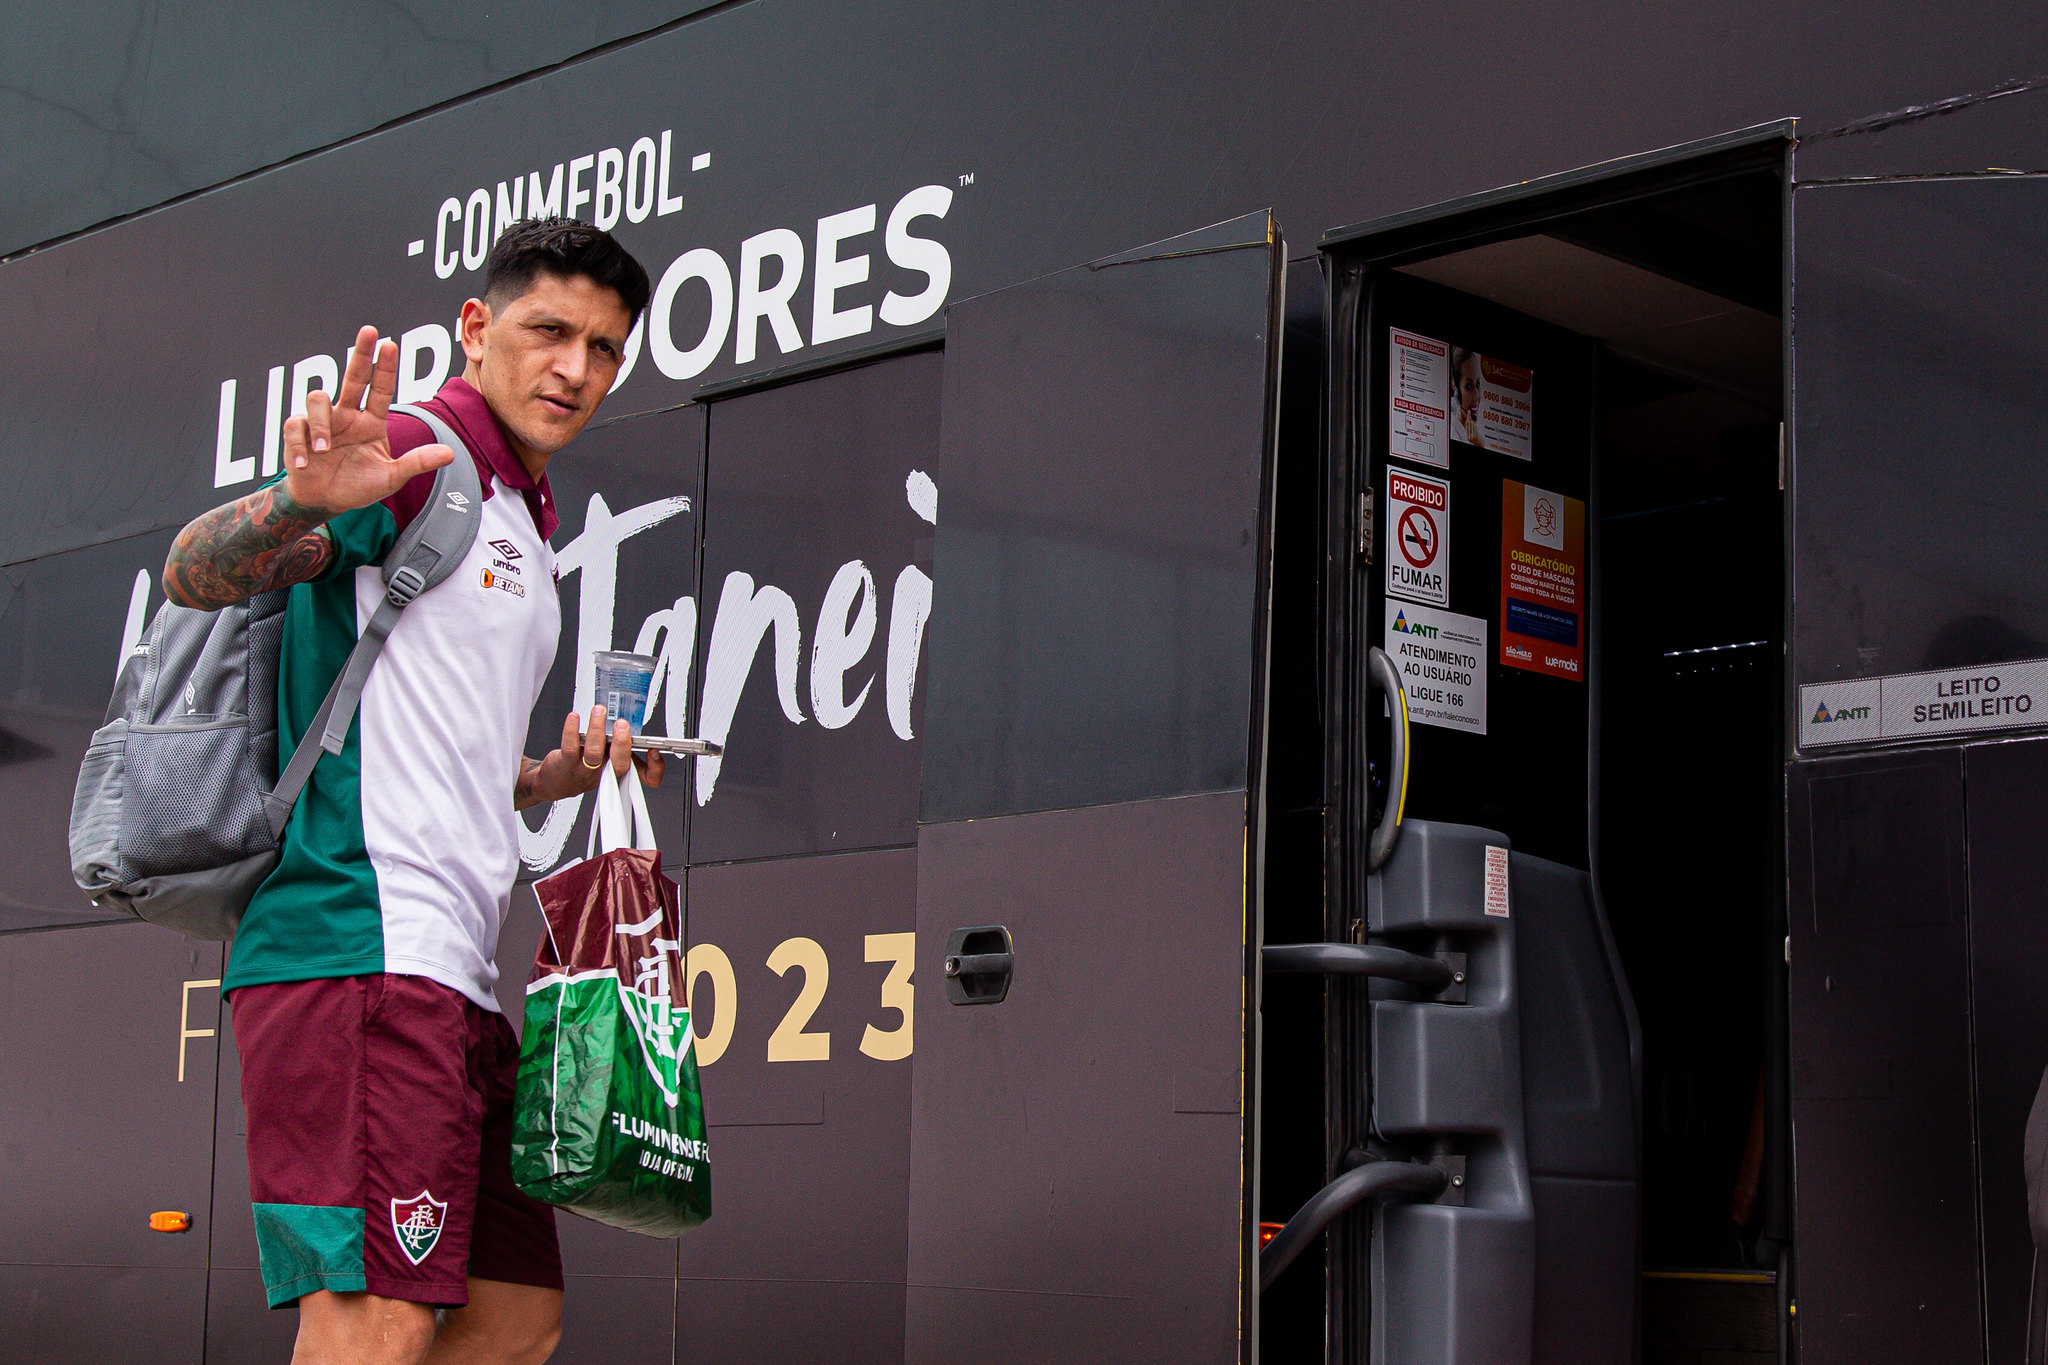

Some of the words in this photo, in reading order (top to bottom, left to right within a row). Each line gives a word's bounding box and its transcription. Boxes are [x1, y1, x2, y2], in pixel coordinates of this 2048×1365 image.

[434, 129, 683, 279] CONMEBOL
[1393, 479, 1443, 507] PROIBIDO
[446, 503, 467, 514] umbro
[493, 558, 521, 575] umbro
[1511, 549, 1575, 576] OBRIGATÓRIO
[1392, 565, 1442, 592] FUMAR
[1510, 562, 1517, 571] O
[1517, 563, 1532, 575] USO
[1532, 568, 1542, 578] DE
[1543, 570, 1575, 587] MÁSCARA
[1510, 573, 1539, 586] COBRINDO
[493, 576, 526, 598] BETANO
[1510, 582, 1535, 594] DURANTE
[1535, 588, 1550, 598] TODA
[1410, 622, 1439, 640] ANTT
[1399, 642, 1476, 669] ATENDIMENTO
[1545, 655, 1578, 673] wemobi
[1404, 661, 1420, 676] AO
[1423, 665, 1472, 686] USUÁRIO
[1410, 685, 1443, 703] LIGUE
[1446, 692, 1464, 707] 166
[1937, 675, 2001, 698] LEITO
[1833, 706, 1871, 722] ANTT
[1913, 693, 2032, 723] SEMILEITO
